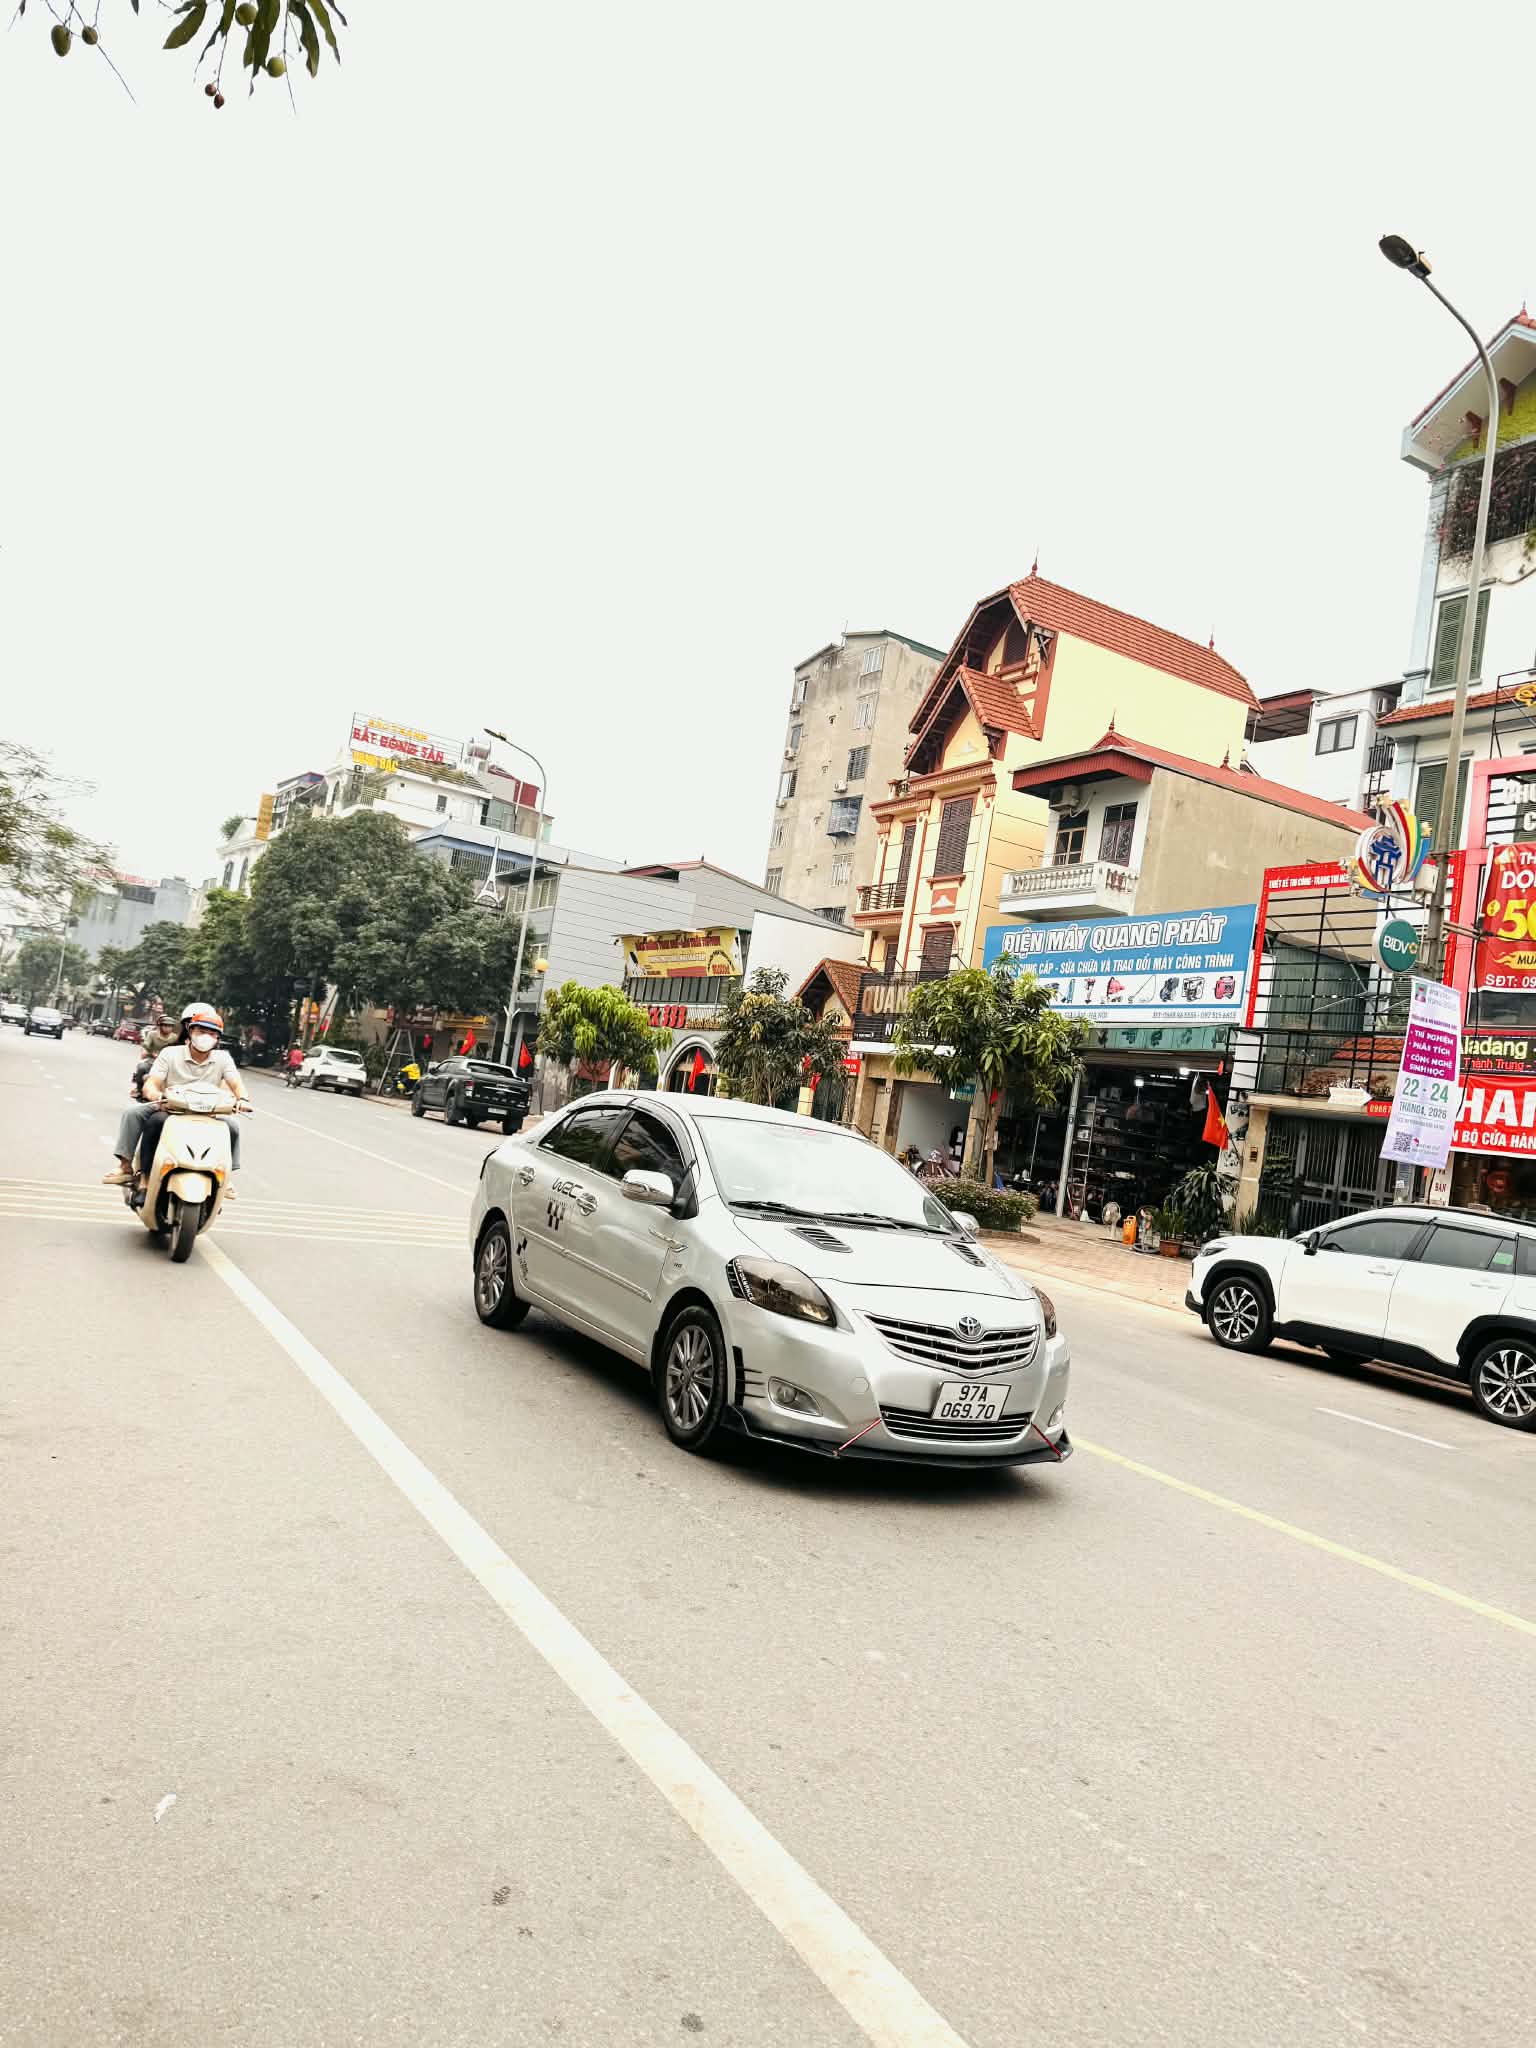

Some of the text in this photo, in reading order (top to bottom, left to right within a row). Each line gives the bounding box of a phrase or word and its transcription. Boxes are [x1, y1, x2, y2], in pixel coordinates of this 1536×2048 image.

[1002, 912, 1228, 958] ĐIỆN MÁY QUANG PHÁT
[1383, 935, 1409, 955] BIDV
[1175, 955, 1202, 969] CÔNG
[1204, 951, 1235, 968] TRÌNH
[1402, 1077, 1420, 1098] 22
[1430, 1083, 1449, 1103] 24
[1462, 1128, 1479, 1146] BỘ
[1482, 1129, 1507, 1147] CỬA
[959, 1385, 988, 1401] 97A
[941, 1402, 996, 1419] 069.70
